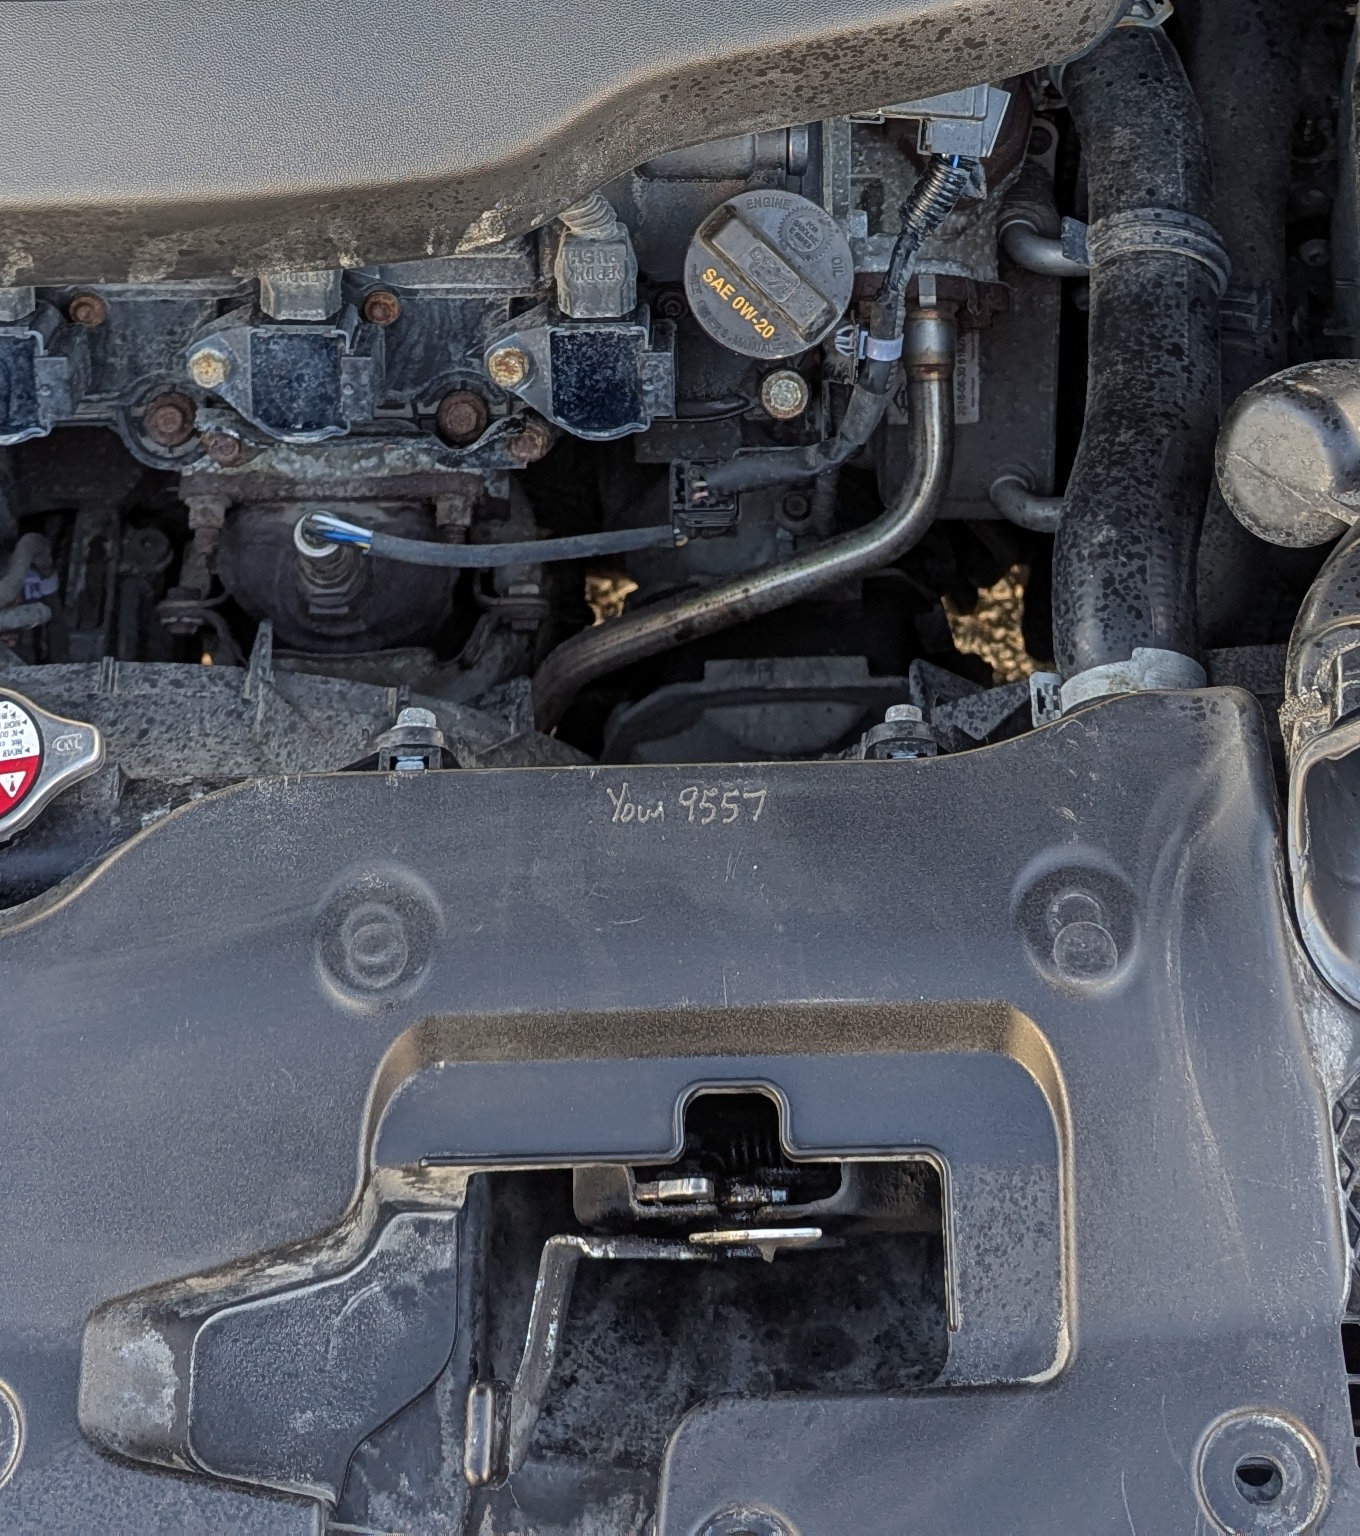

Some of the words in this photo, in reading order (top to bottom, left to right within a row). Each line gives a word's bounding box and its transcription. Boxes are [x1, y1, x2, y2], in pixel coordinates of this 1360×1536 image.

[746, 196, 790, 210] ENGINE
[832, 256, 846, 277] OIL
[702, 267, 736, 301] SAE
[731, 296, 775, 339] 0W-20
[678, 785, 767, 826] 9557
